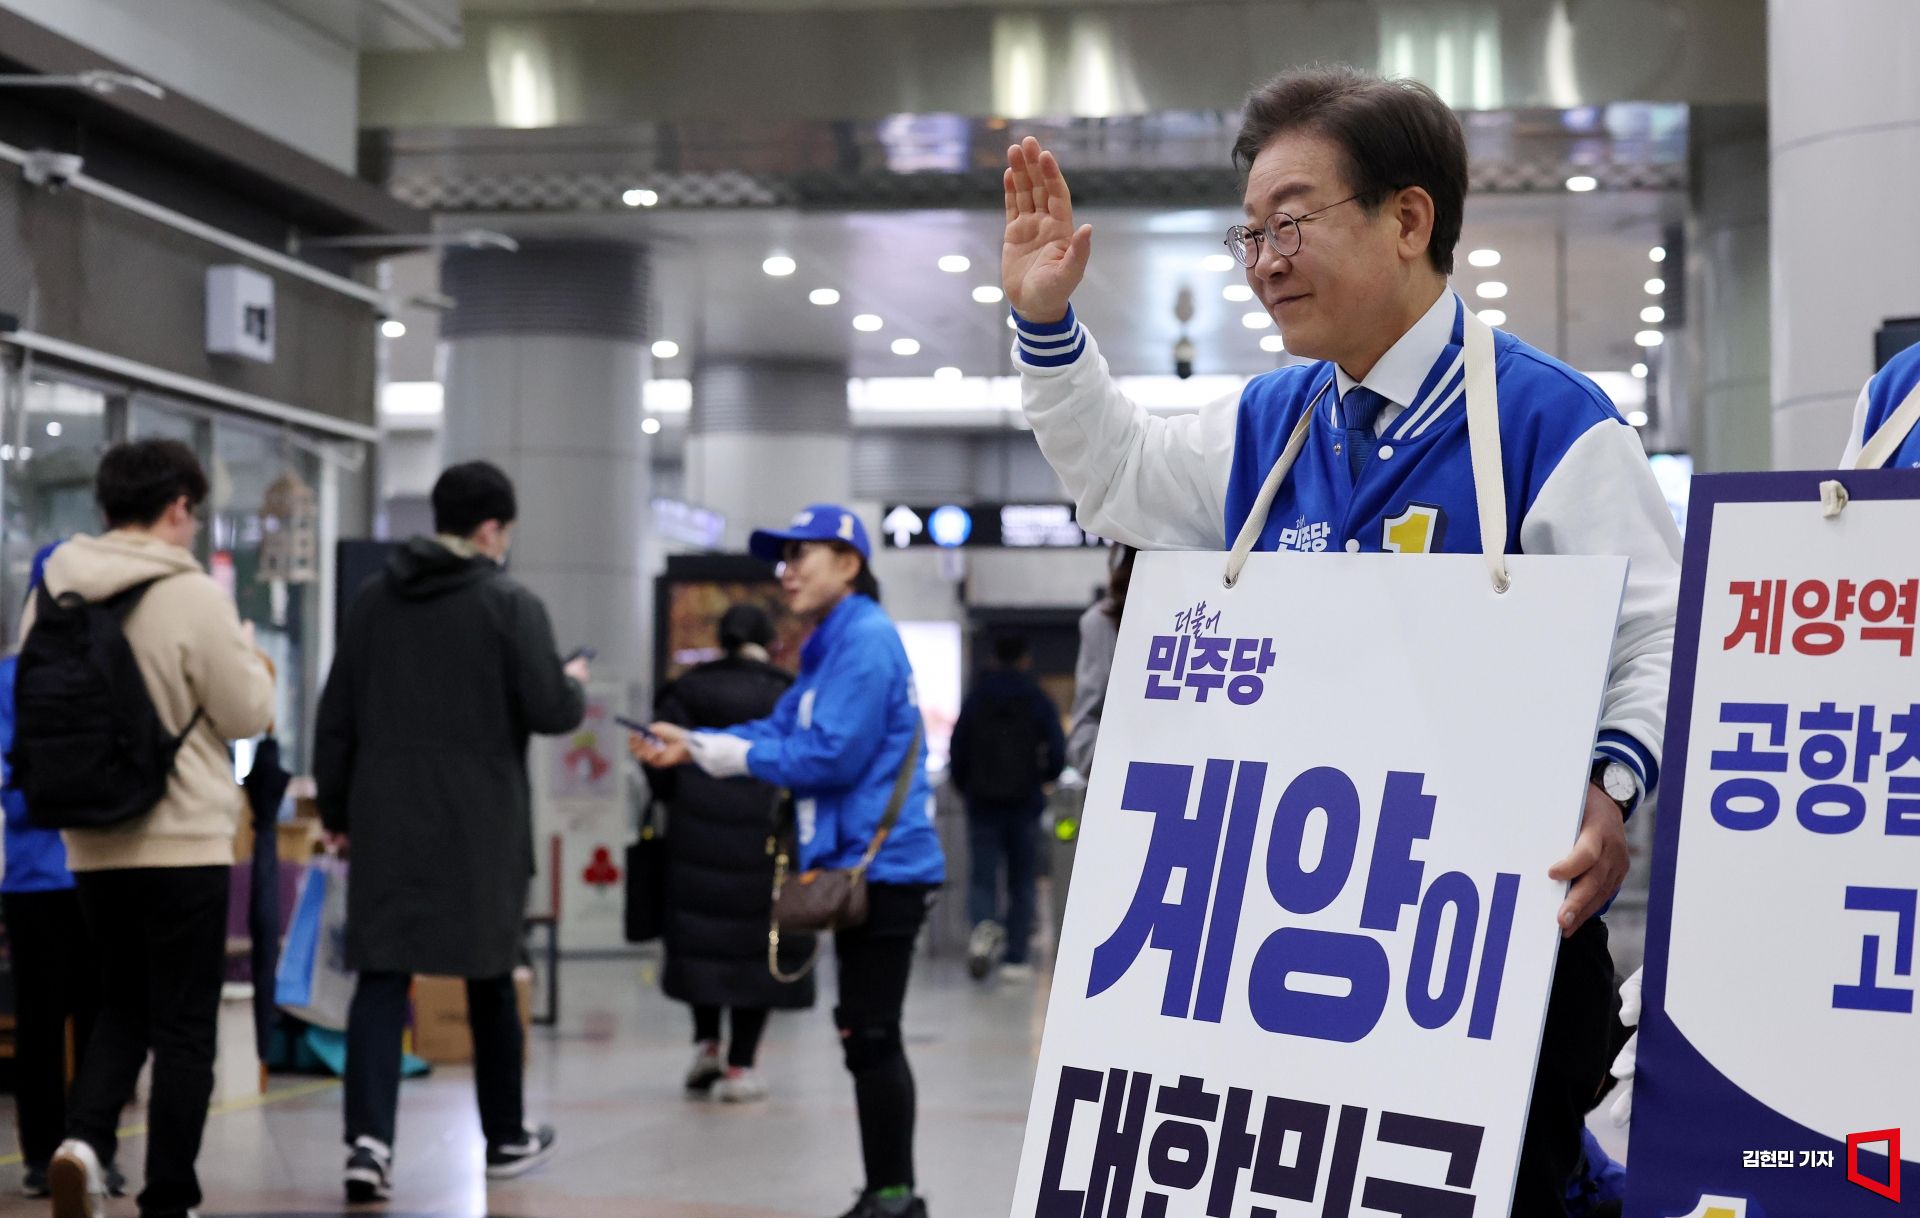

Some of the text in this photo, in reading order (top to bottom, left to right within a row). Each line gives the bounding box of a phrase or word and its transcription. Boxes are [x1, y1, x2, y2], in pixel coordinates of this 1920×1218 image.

[1277, 521, 1331, 552] 민주당
[1382, 504, 1439, 553] 1
[1174, 600, 1222, 639] 더불어
[1722, 578, 1919, 656] 계양역
[1144, 634, 1277, 706] 민주당
[1086, 757, 1521, 1044] 계양이
[1832, 885, 1918, 1013] 고
